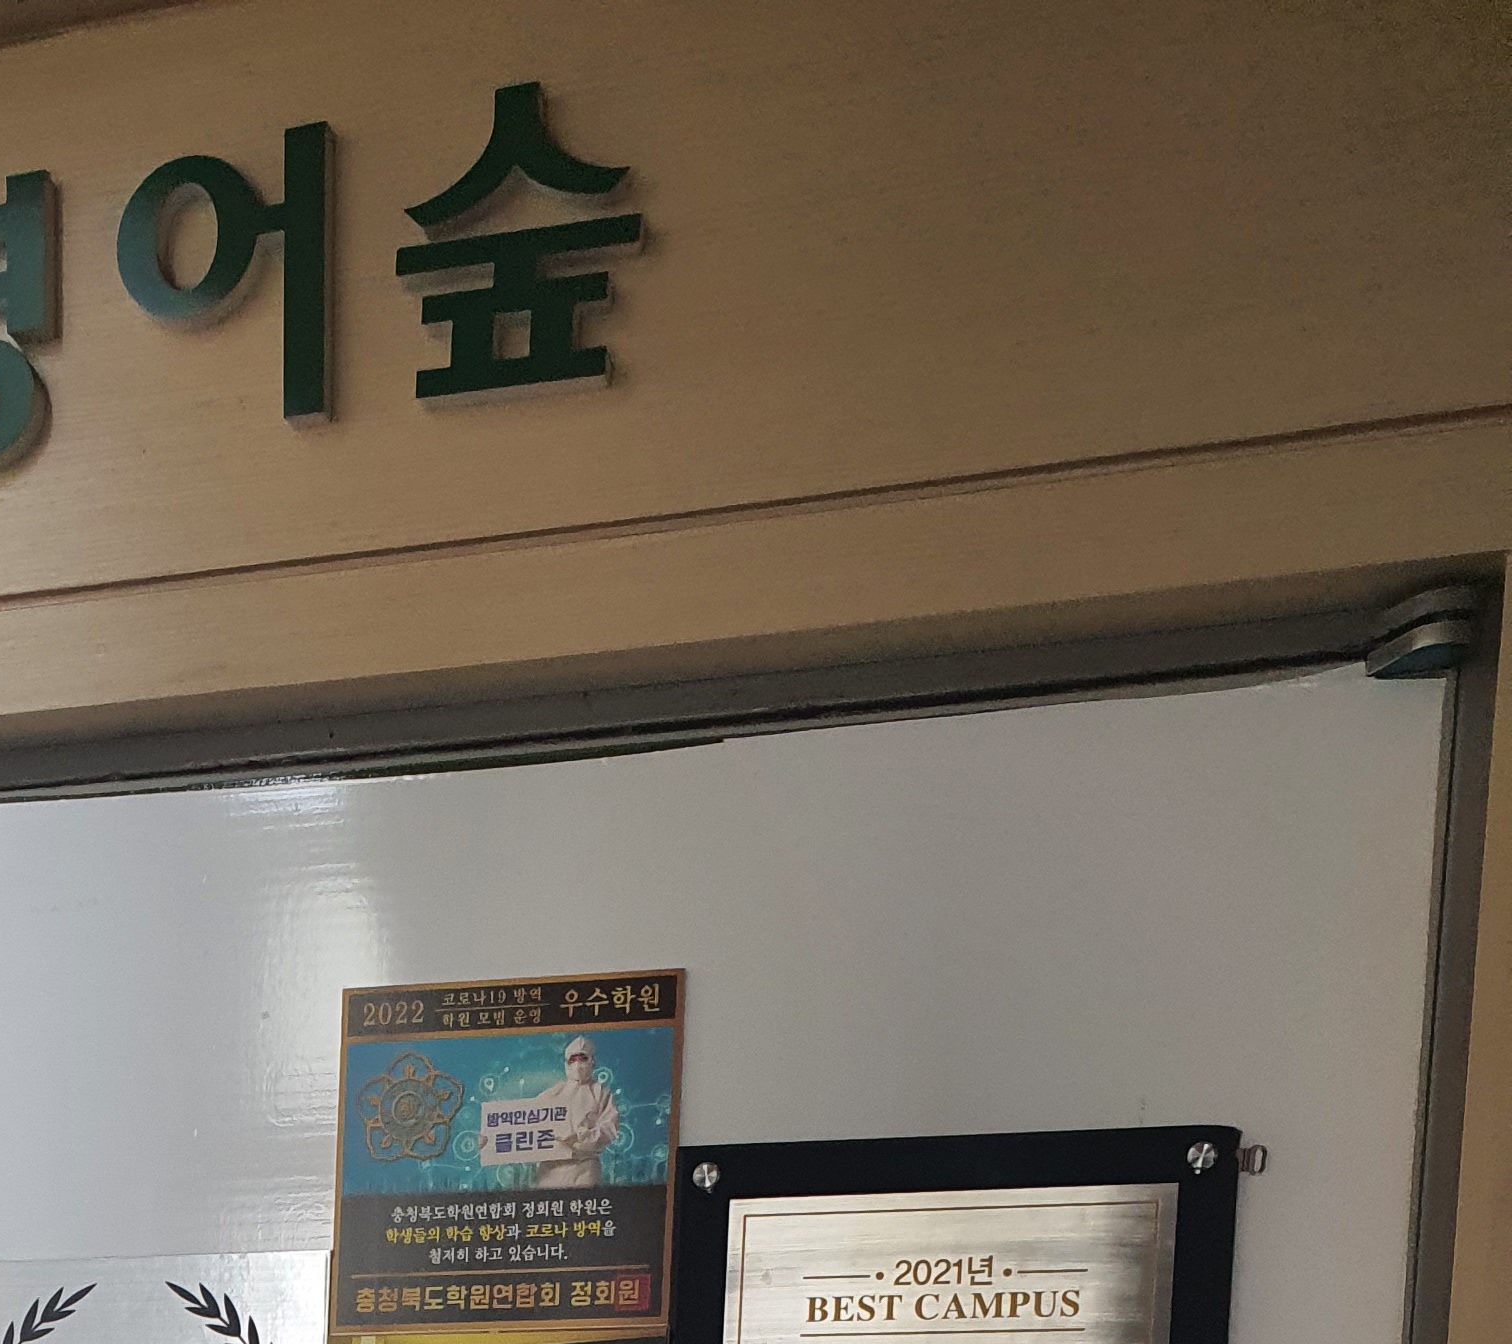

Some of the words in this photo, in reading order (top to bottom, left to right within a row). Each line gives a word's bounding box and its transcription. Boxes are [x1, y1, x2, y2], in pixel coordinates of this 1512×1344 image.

[442, 989, 506, 1006] 코로나19
[514, 987, 542, 1004] 방역
[560, 983, 661, 1018] 우수학원
[363, 1000, 426, 1027] 2022
[442, 1012, 470, 1028] 학원
[477, 1011, 505, 1026] 모범
[514, 1008, 542, 1025] 운영
[487, 1106, 567, 1127] 방역안심기관
[495, 1129, 555, 1153] 클린존
[391, 1202, 516, 1223] 충청북도학원연합회
[522, 1200, 564, 1218] 정회원
[570, 1198, 613, 1216] 학원은
[386, 1225, 441, 1243] 학생들의
[446, 1224, 473, 1242] 학습
[479, 1223, 520, 1241] 향상과
[526, 1221, 568, 1239] 코로나
[573, 1220, 616, 1238] 방역을
[429, 1246, 469, 1264] 철저히
[475, 1245, 503, 1262] 하고
[508, 1244, 568, 1262] 있습니다.
[894, 1256, 994, 1287] 2021년
[356, 1281, 560, 1313] 충청북도학원연합회
[571, 1279, 640, 1307] 정회원
[805, 1295, 902, 1323] BEST
[914, 1289, 1081, 1321] CAMPUS
